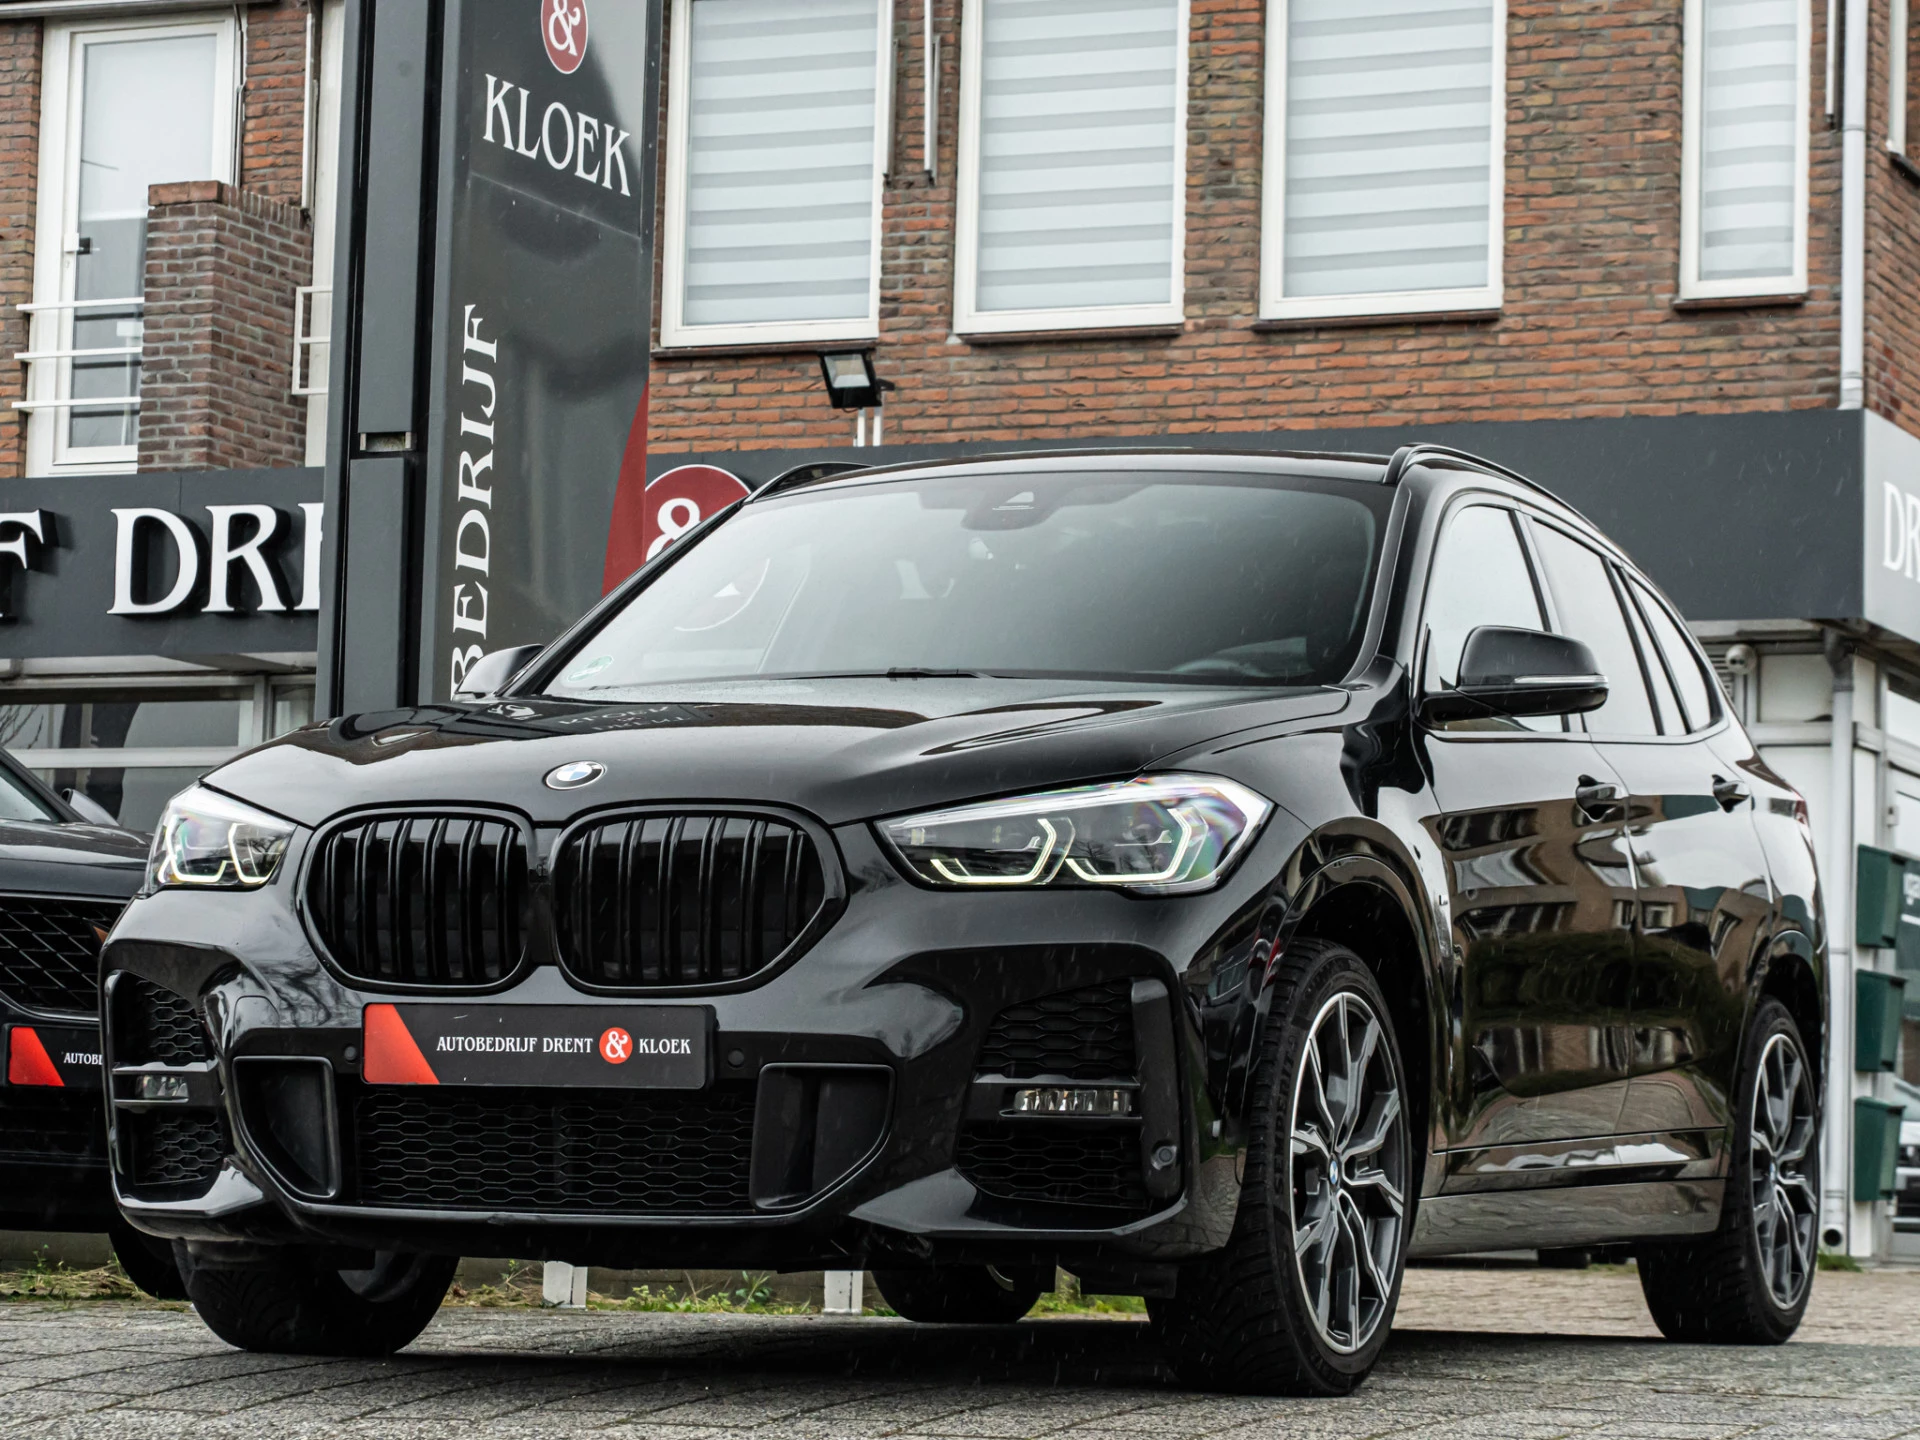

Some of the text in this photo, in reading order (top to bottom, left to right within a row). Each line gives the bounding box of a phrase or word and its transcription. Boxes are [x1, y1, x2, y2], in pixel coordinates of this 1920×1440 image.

[482, 73, 631, 197] KLOEK
[436, 1031, 692, 1059] AUTOBEDRIJF DRENT & KLOEK
